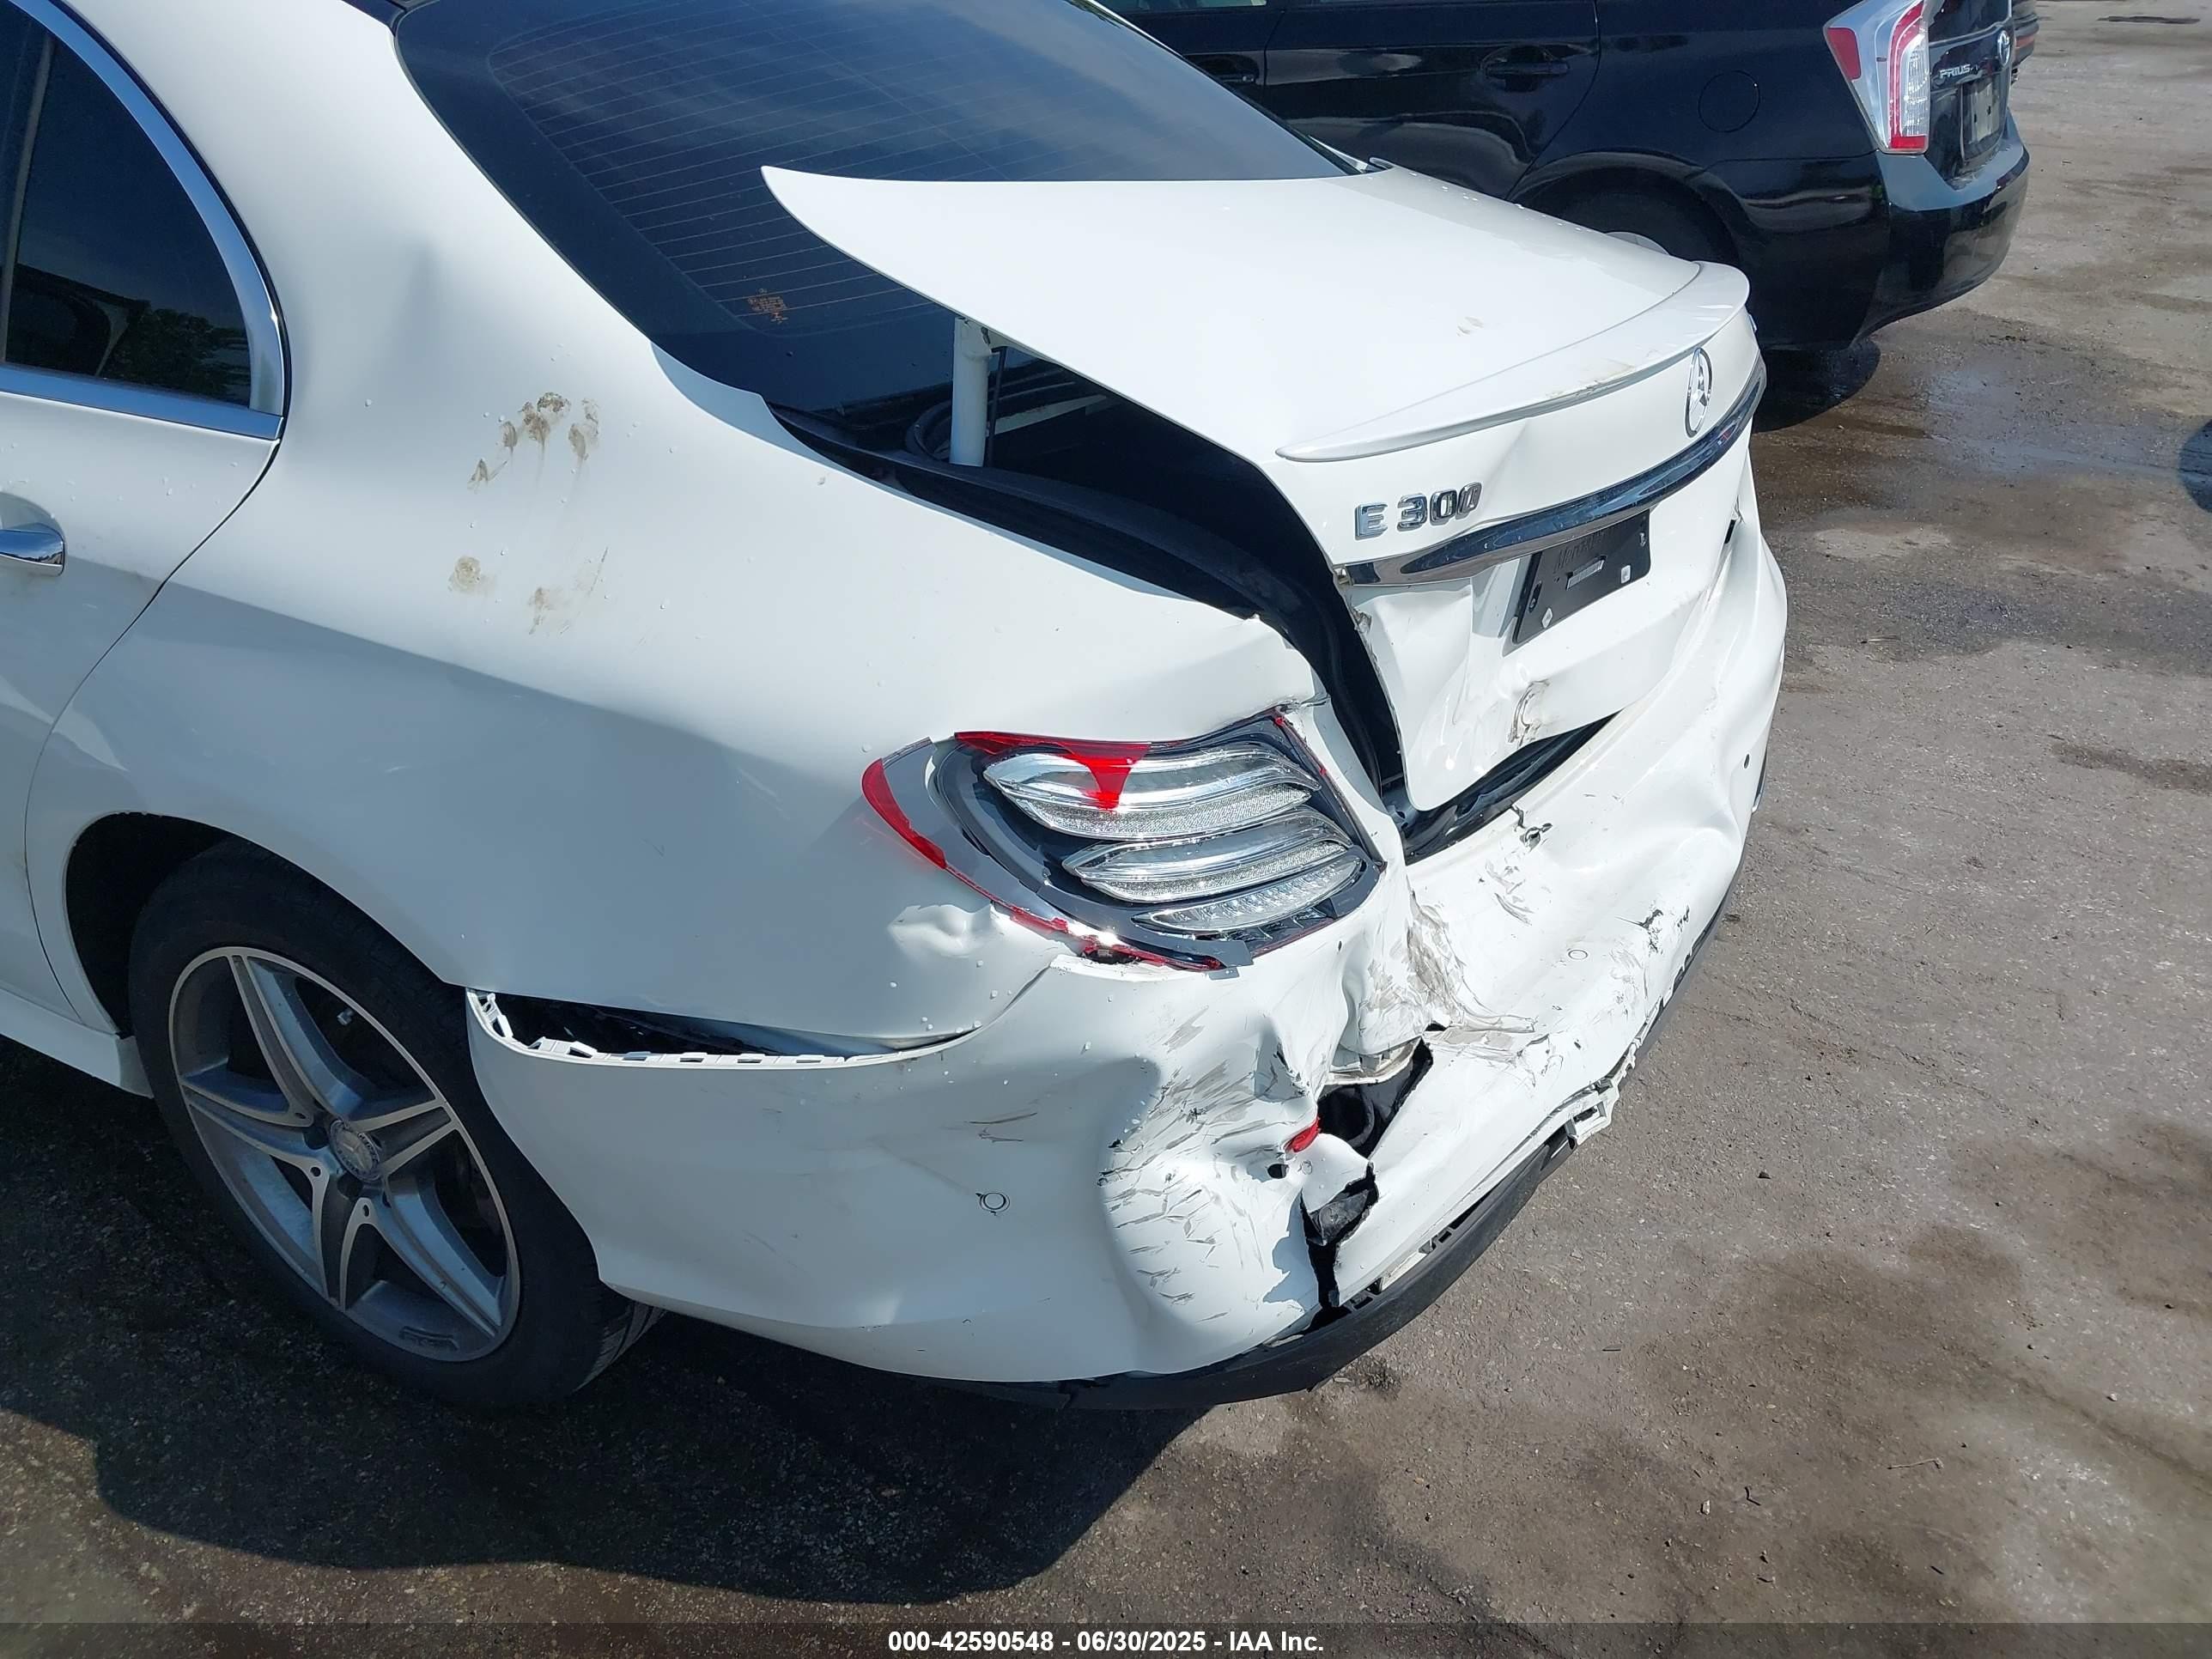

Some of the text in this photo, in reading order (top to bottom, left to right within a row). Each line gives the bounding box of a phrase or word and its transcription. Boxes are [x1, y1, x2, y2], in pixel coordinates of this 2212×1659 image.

[1939, 64, 1971, 79] PRIUS
[1354, 482, 1482, 540] E 300
